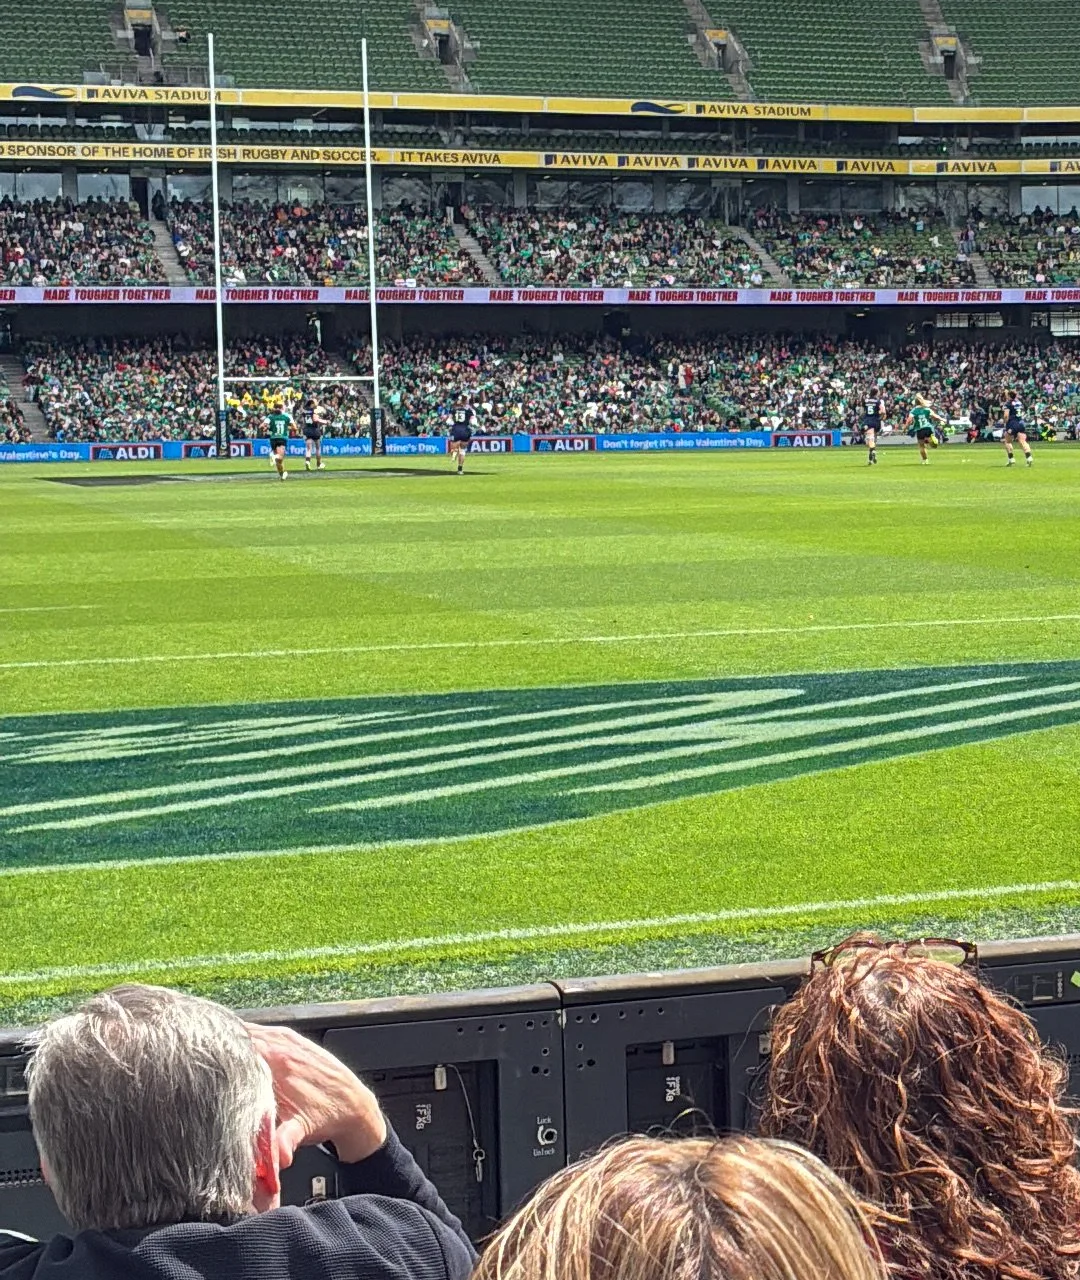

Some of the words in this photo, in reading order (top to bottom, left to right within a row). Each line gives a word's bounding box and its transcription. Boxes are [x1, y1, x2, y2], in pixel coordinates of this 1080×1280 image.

[102, 88, 148, 100] AVIVA
[155, 90, 222, 101] STADIUM
[709, 105, 748, 115] AVIVA
[754, 106, 811, 117] STADIUM
[8, 145, 76, 157] SPONSOR
[81, 146, 99, 158] OF
[103, 146, 130, 158] THE
[133, 147, 174, 159] HOME
[177, 147, 194, 159] OF
[199, 148, 237, 161] IRSH
[243, 149, 287, 162] RUGBY
[290, 150, 320, 162] AND
[400, 151, 415, 163] IT
[417, 151, 459, 164] TAKES
[461, 153, 501, 164] AVIVA
[561, 155, 608, 166] AVIVA
[633, 156, 680, 167] AVIVA
[702, 157, 749, 169] AVIVA
[772, 159, 817, 170] AVIVA
[852, 160, 896, 172] AVIVA
[952, 161, 998, 173] AVIVA
[43, 289, 70, 300] MADE
[74, 289, 120, 300] TOUGHER
[122, 289, 171, 300] TOGETHER
[195, 289, 216, 300] MAD
[226, 289, 269, 300] TOUGHER
[271, 289, 318, 300] TOGETHER
[345, 289, 369, 301] MADE
[419, 289, 464, 301] TOGETHER
[489, 289, 513, 301] MADE
[517, 290, 557, 301] TOUGHER
[561, 290, 604, 301] TOGETHER
[628, 291, 651, 301] MADE
[655, 291, 694, 301] TOUGHER
[696, 291, 738, 301] TOGETHER
[770, 291, 792, 301] MADE
[796, 291, 833, 301] TOUGHER
[835, 291, 875, 301] TOGETHER
[897, 291, 919, 301] MADE
[922, 291, 959, 301] TOUGHER
[961, 290, 1002, 301] TOGETHER
[1025, 290, 1048, 301] MADE
[470, 441, 506, 452] ALDI
[554, 440, 589, 451] ALDI
[793, 435, 826, 447] ALDI
[116, 447, 155, 459] ALDI
[208, 445, 245, 457] ADI
[418, 443, 439, 454] Day.
